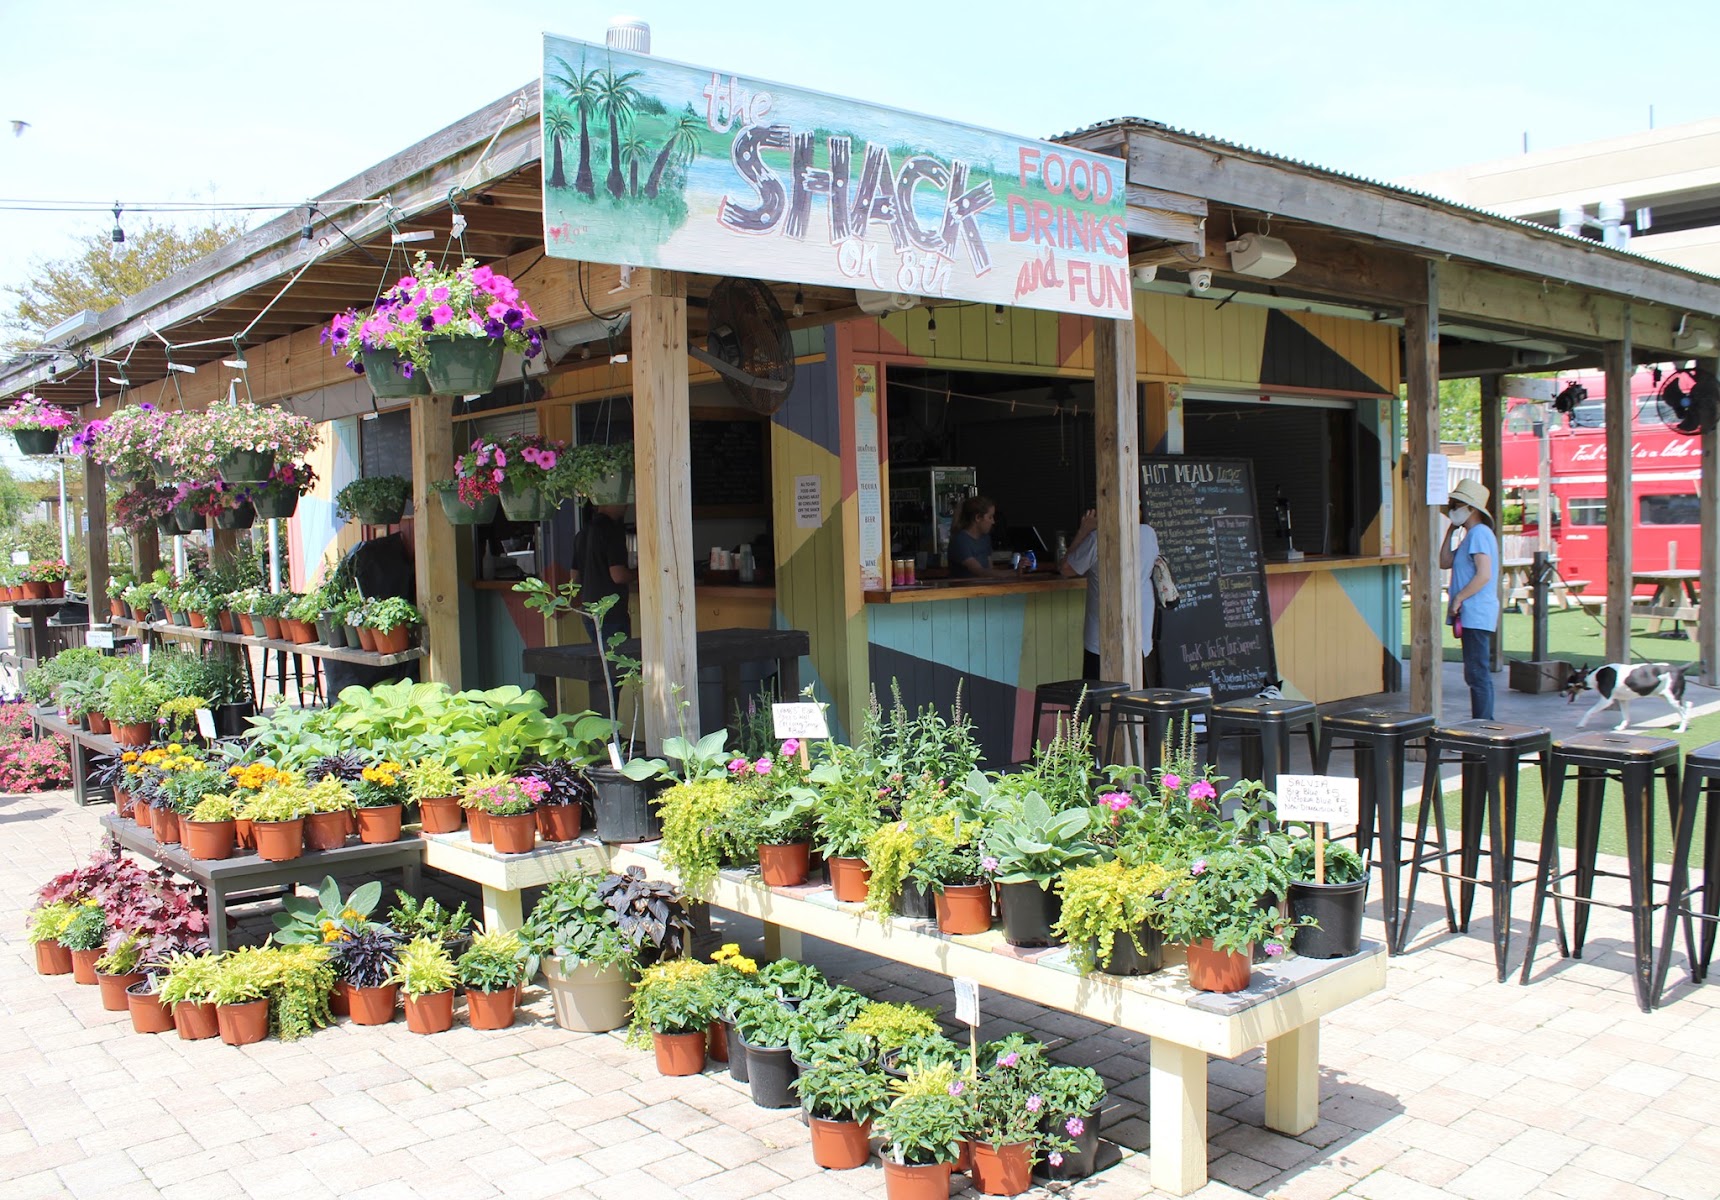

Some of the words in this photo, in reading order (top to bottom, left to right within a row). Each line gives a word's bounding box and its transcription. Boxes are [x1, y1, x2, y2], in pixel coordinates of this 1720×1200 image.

[703, 72, 774, 134] the
[1018, 146, 1113, 206] FOOD
[717, 124, 995, 278] SHACK
[1006, 193, 1128, 260] DRINKS
[838, 241, 885, 289] on
[896, 248, 952, 297] 8th
[1013, 247, 1065, 302] and
[1067, 259, 1130, 311] FUN
[1571, 444, 1606, 461] Food
[1659, 438, 1696, 457] little
[1141, 463, 1169, 485] HOT
[1174, 463, 1214, 484] MEALS
[1288, 778, 1329, 788] SALVIA
[1303, 787, 1318, 796] Blue
